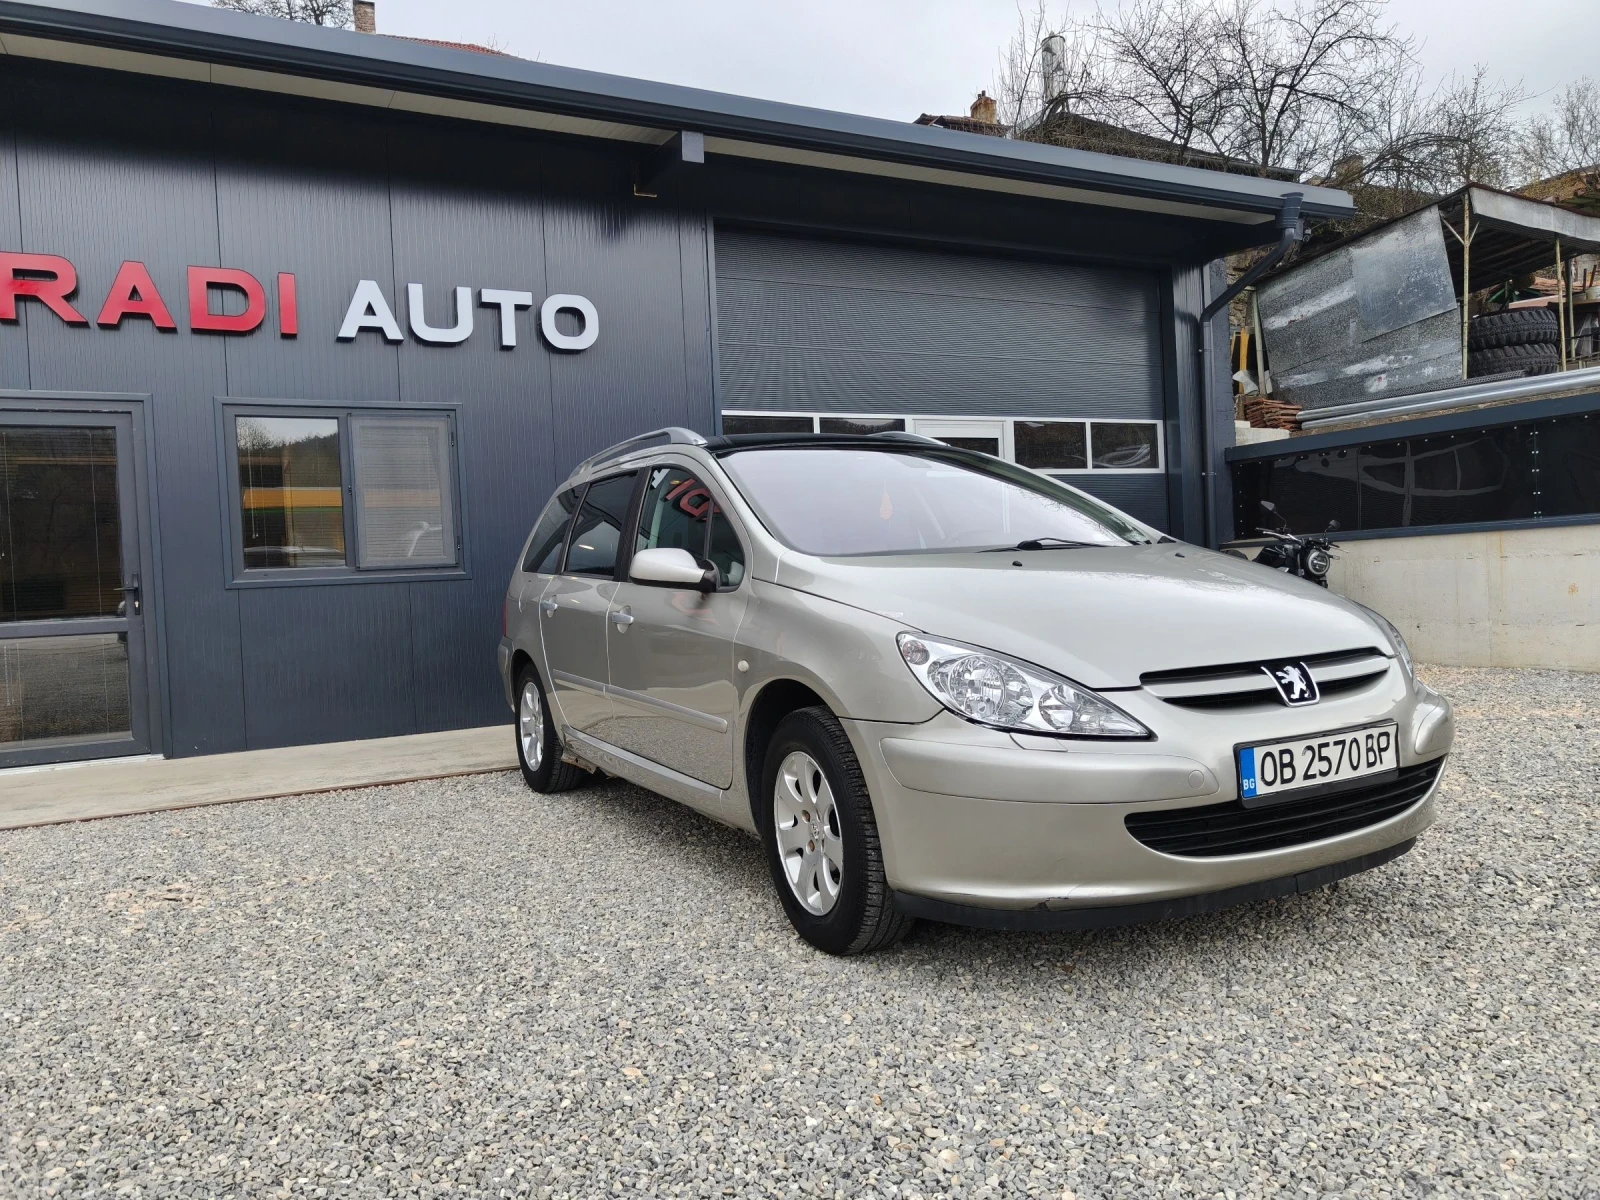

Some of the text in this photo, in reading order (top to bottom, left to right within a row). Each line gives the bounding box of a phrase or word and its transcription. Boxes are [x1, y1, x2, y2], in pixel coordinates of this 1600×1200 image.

[0, 251, 600, 351] RADI AUTO
[1242, 778, 1255, 791] BG
[1260, 731, 1391, 787] OB 2570 BP
